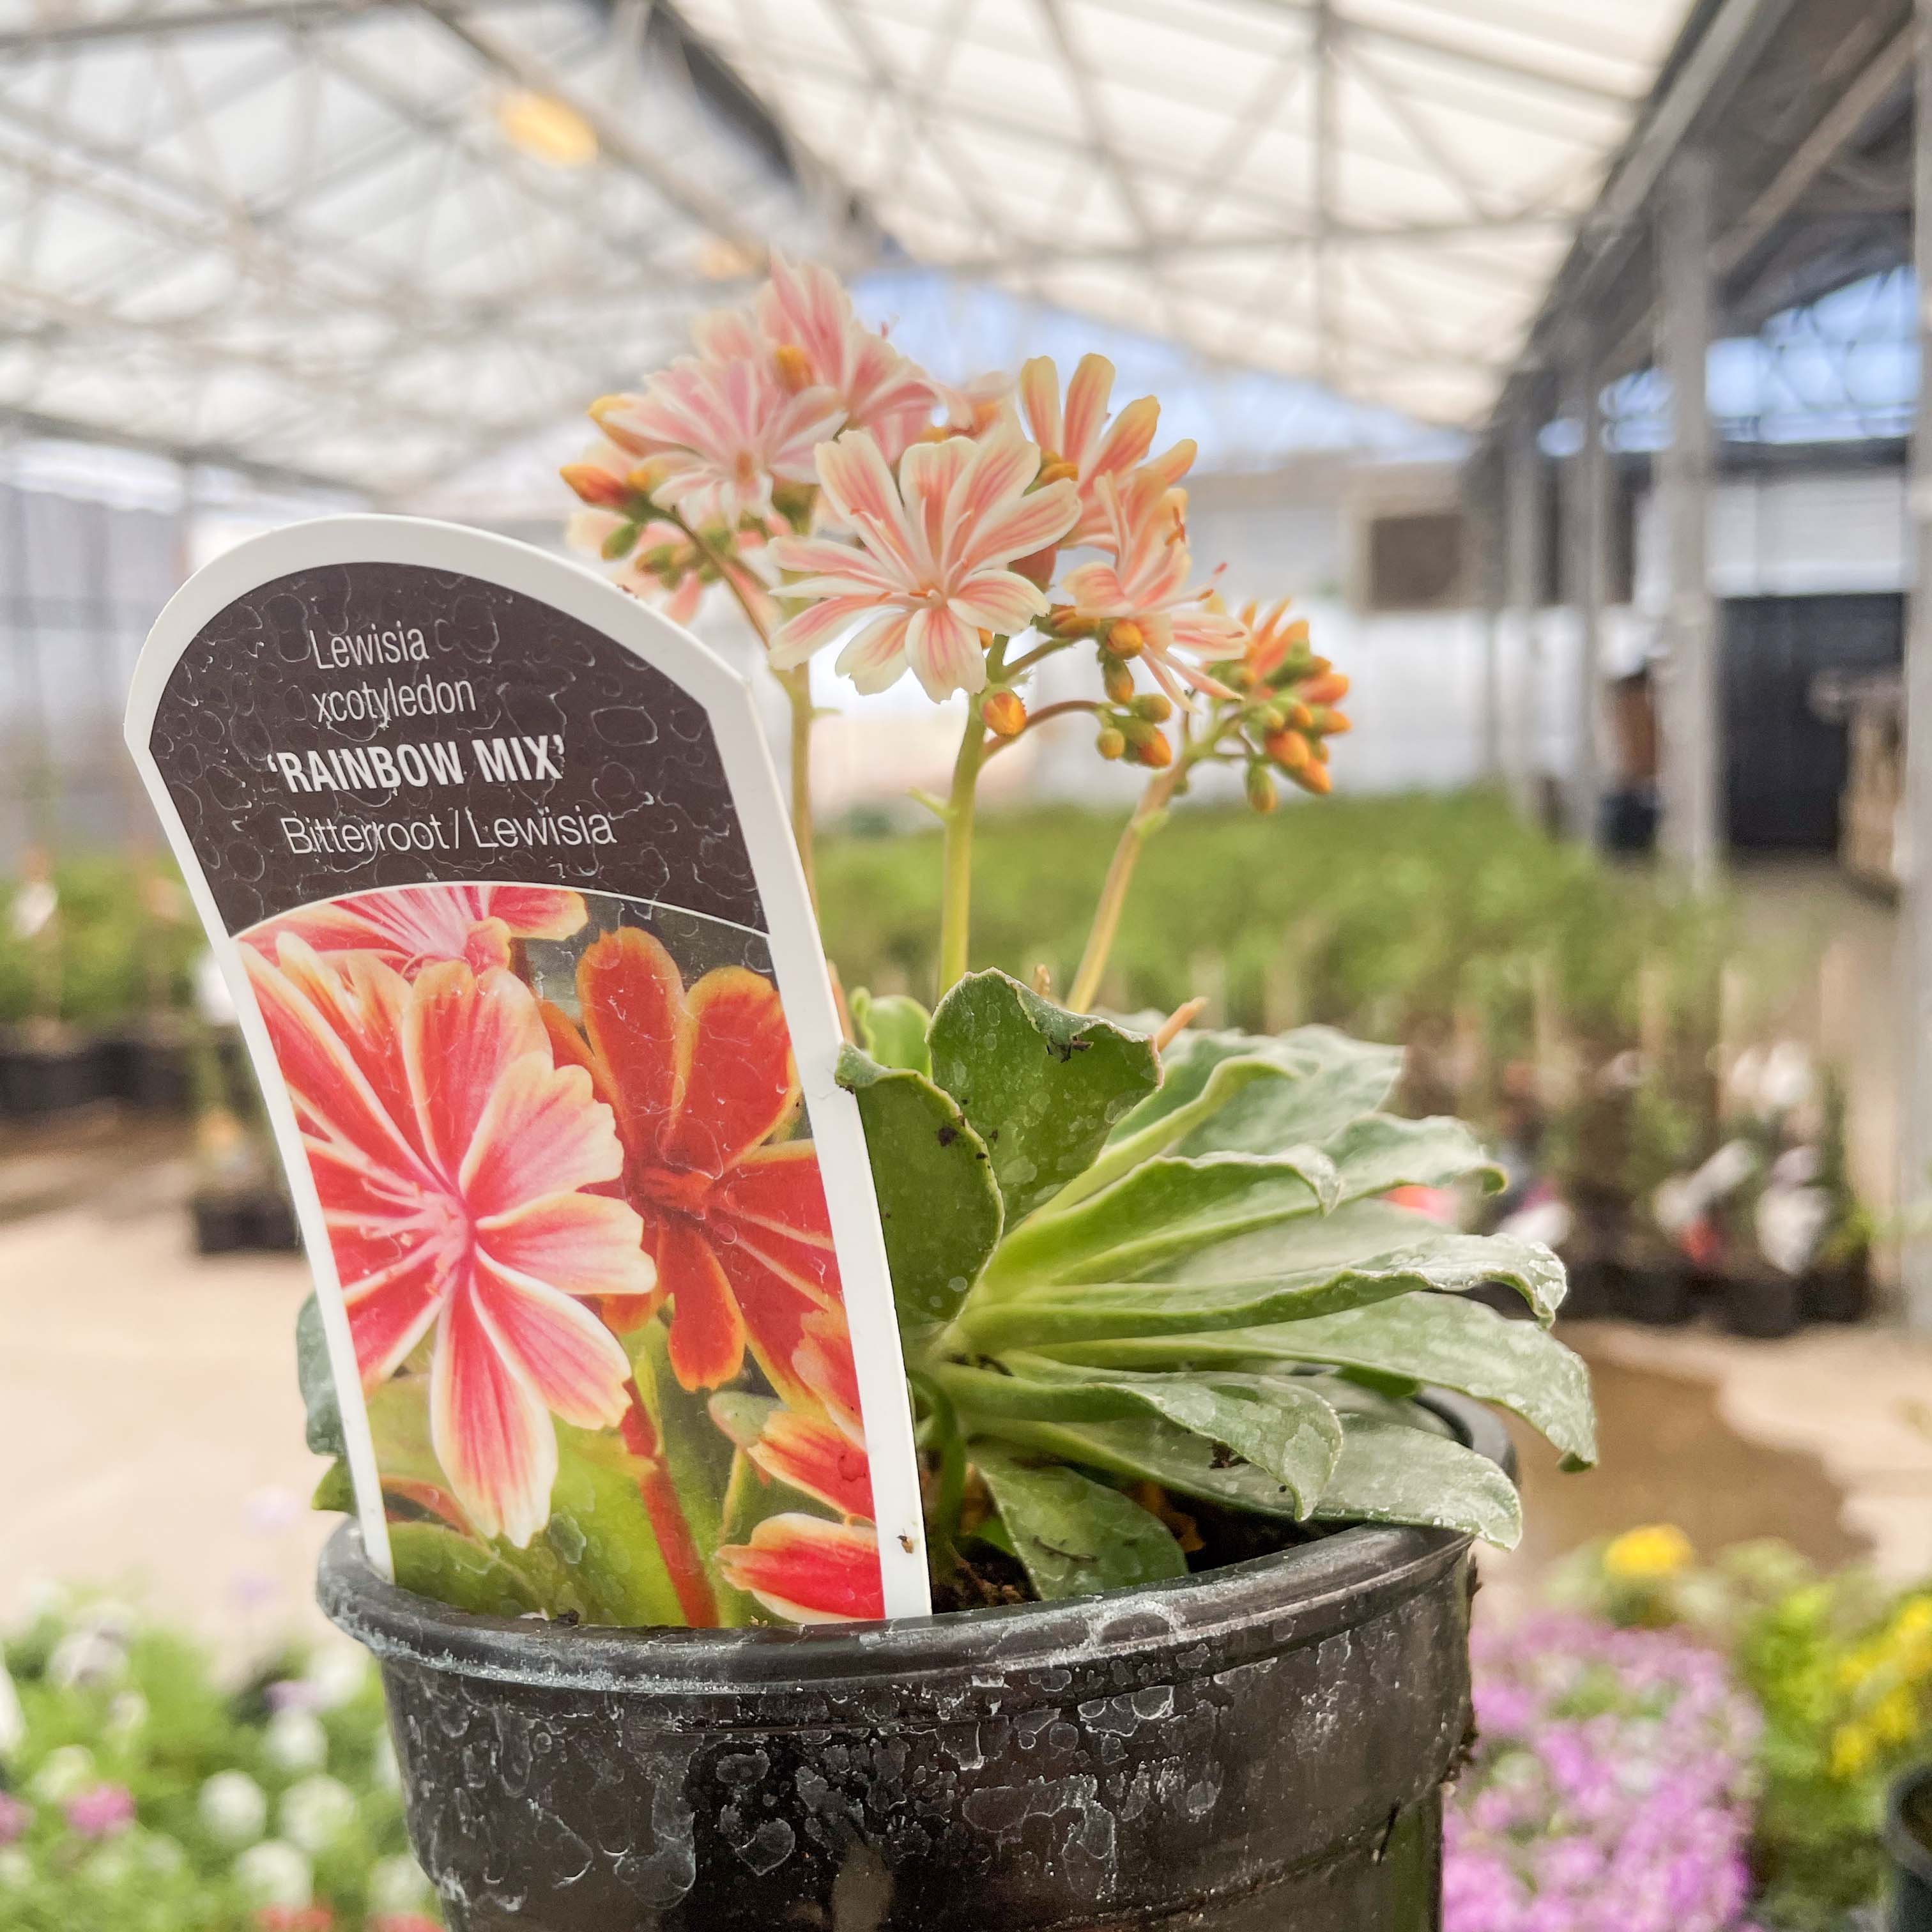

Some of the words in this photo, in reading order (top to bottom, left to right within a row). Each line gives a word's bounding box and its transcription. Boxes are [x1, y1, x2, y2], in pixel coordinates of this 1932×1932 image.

[309, 620, 429, 670] Lewisia
[312, 673, 477, 731] xcotyledon
[465, 807, 617, 848] Lewisia
